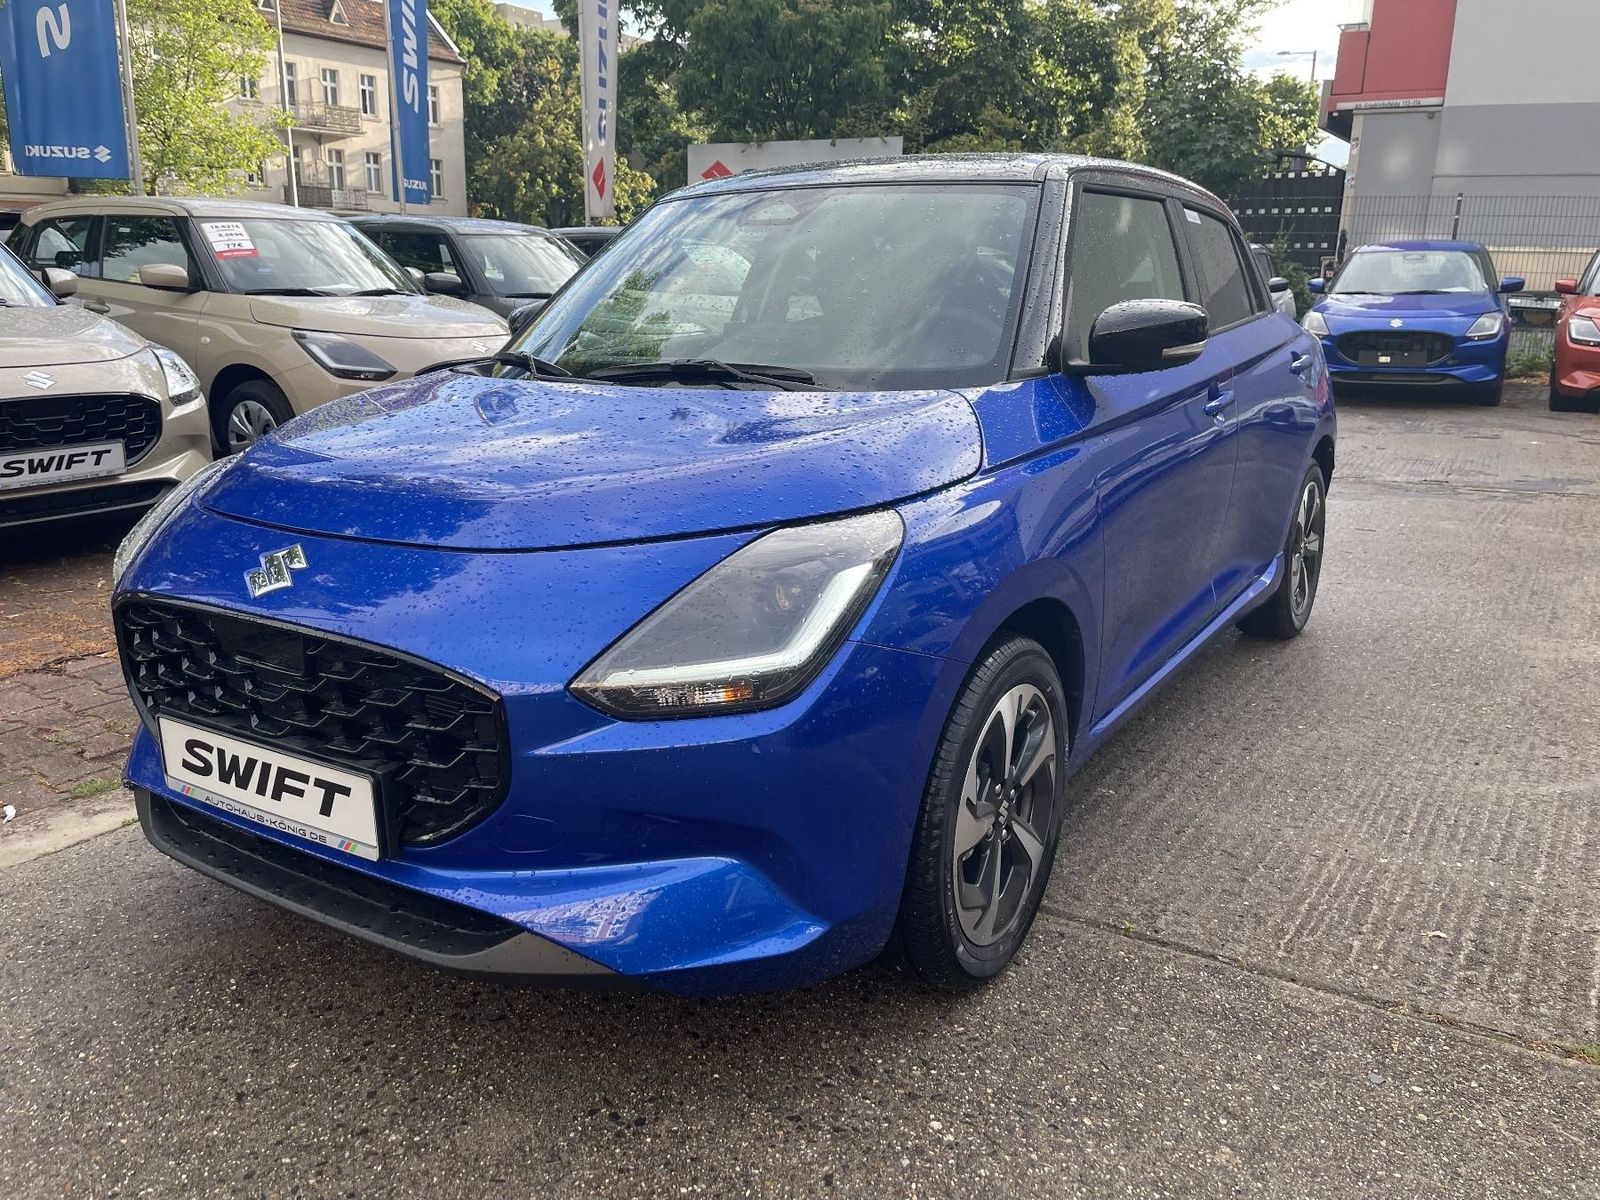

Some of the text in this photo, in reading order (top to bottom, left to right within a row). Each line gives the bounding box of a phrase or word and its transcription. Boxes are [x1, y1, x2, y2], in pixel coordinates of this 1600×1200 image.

[402, 0, 419, 114] SWI
[0, 449, 112, 478] SWIFT
[181, 738, 352, 818] SWIFT
[204, 795, 328, 844] AUTOHAUS-KÖNIG.DE
